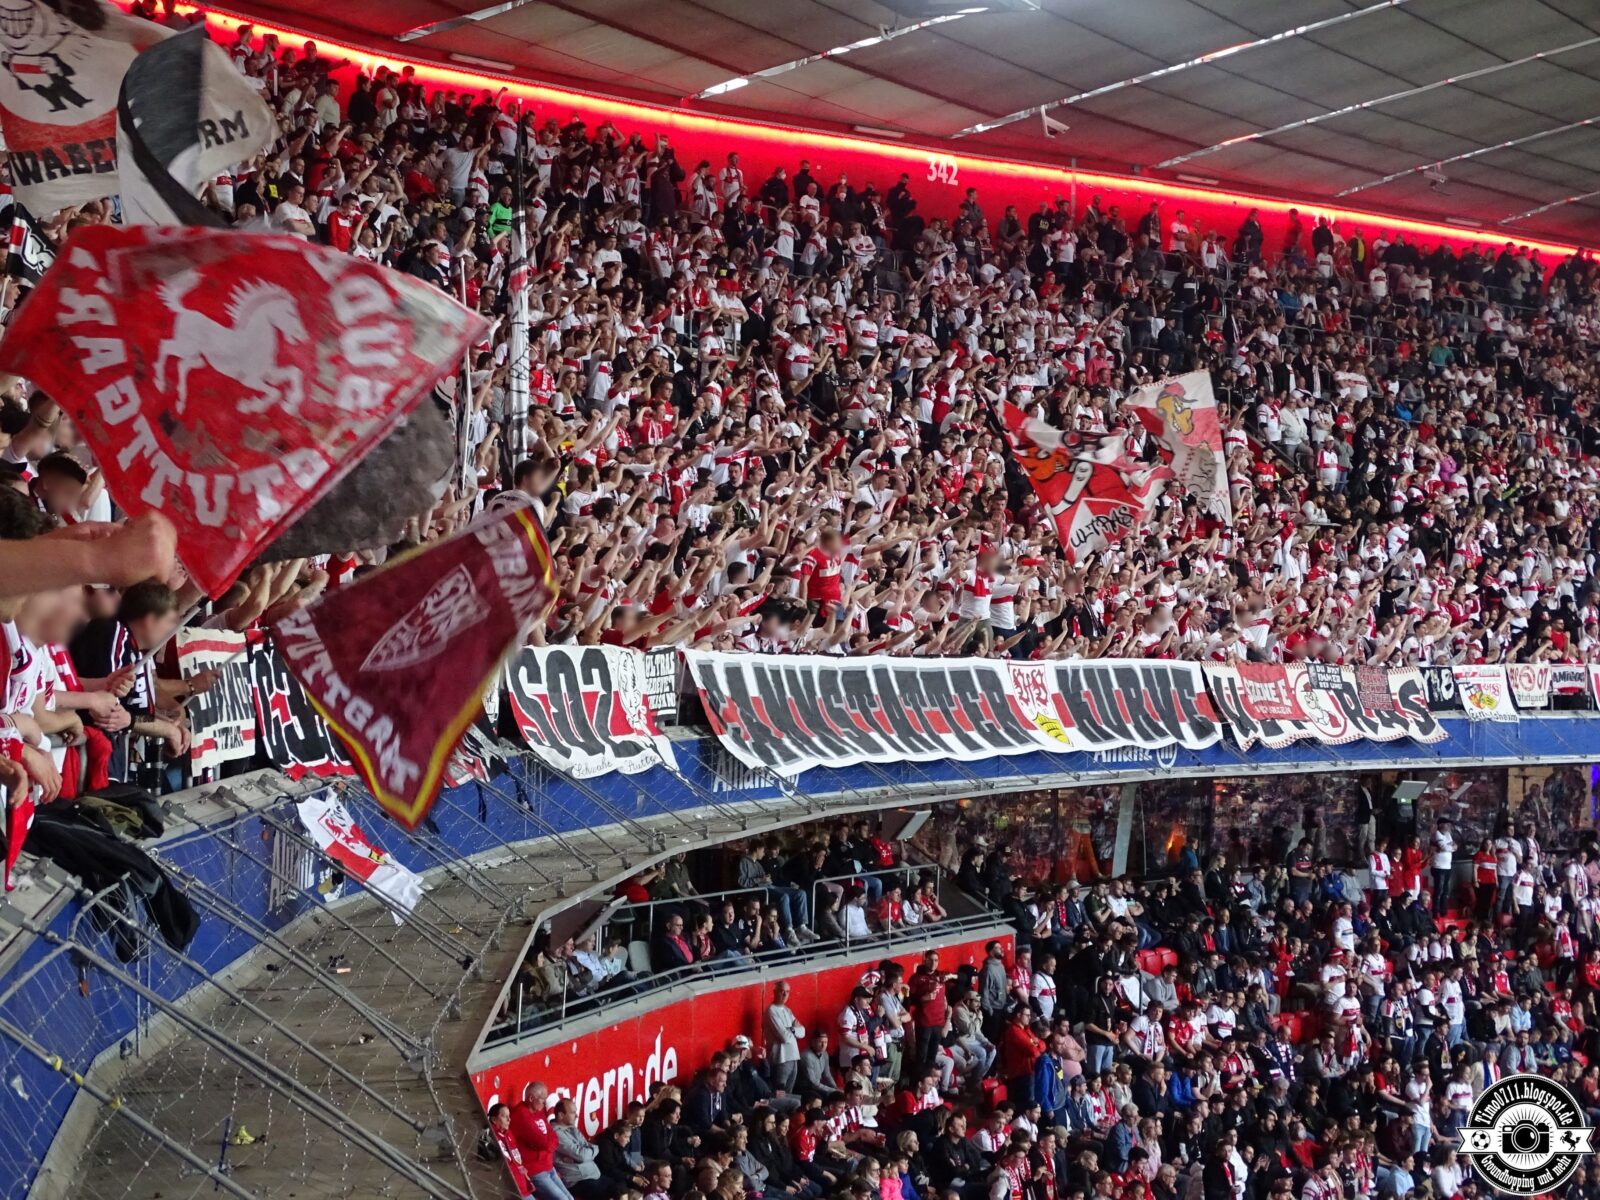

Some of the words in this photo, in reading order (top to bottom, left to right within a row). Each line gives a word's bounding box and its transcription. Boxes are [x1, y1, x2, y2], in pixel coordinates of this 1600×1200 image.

[927, 156, 958, 186] 342
[1070, 505, 1134, 548] ULTRAS
[696, 659, 1042, 769] CANNSTATTER
[1054, 664, 1222, 745] KURVE
